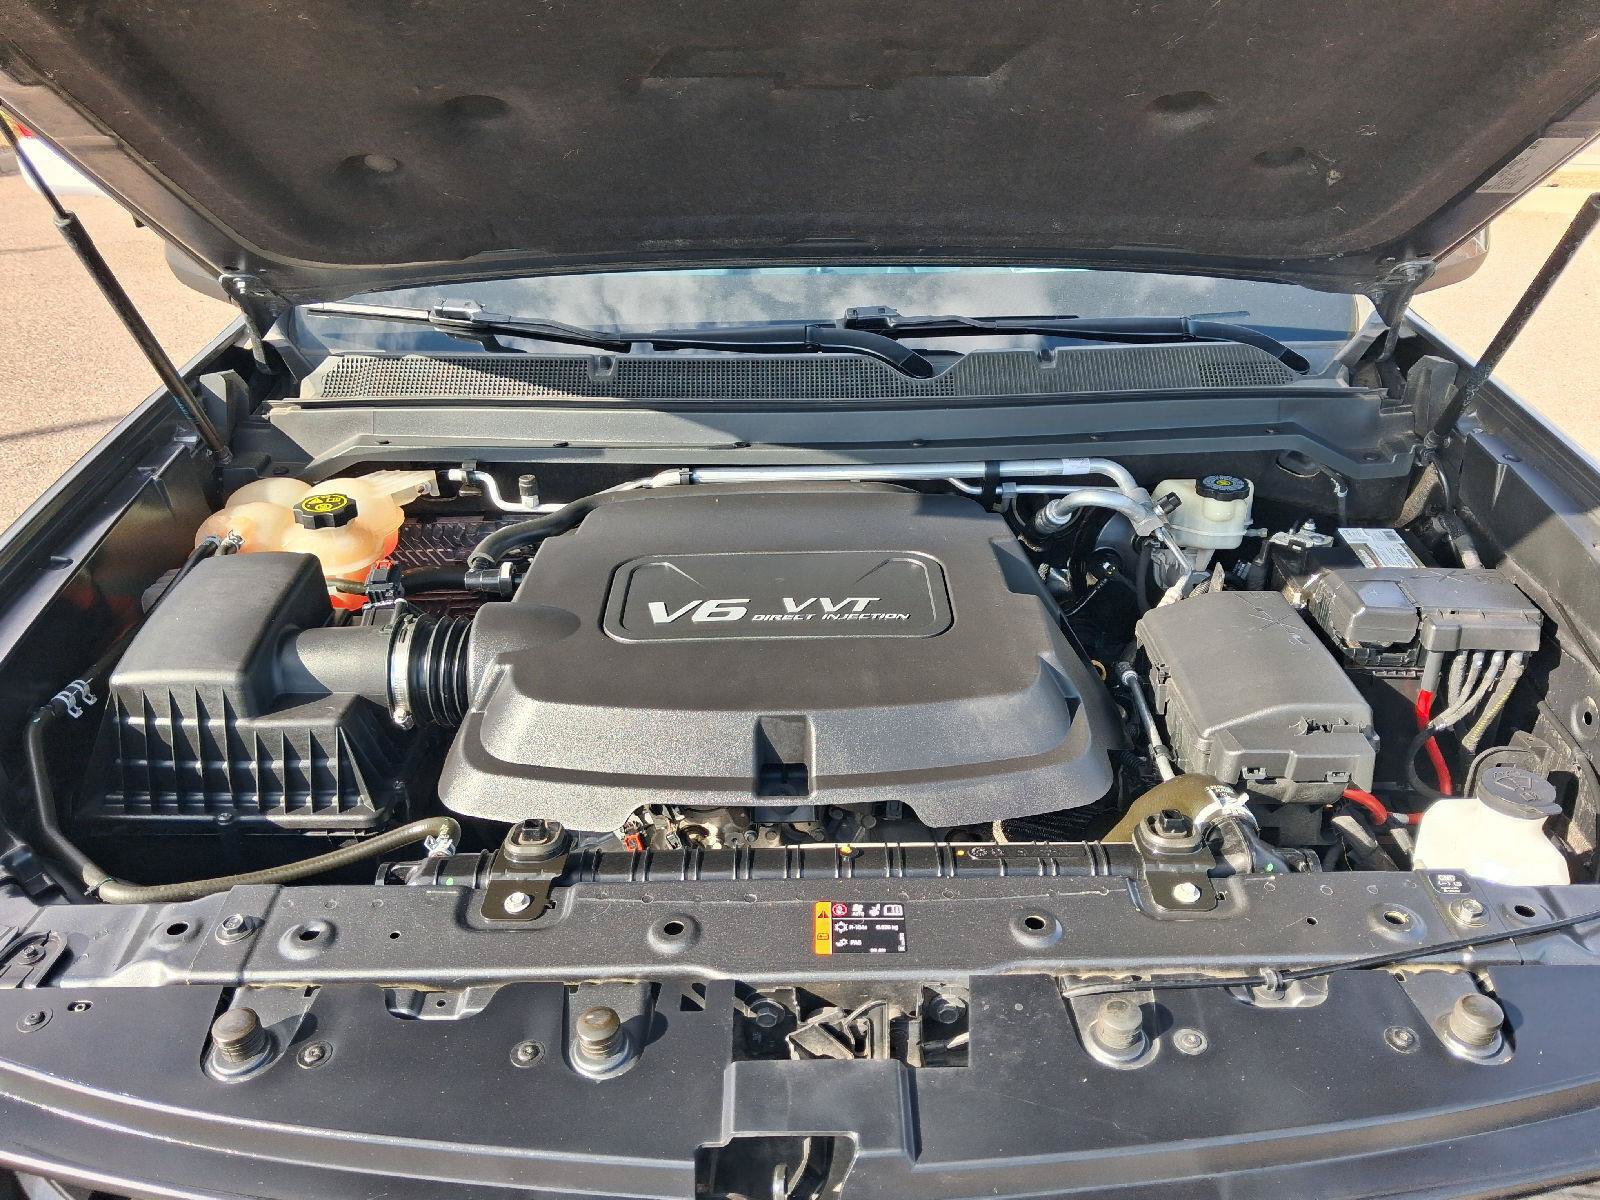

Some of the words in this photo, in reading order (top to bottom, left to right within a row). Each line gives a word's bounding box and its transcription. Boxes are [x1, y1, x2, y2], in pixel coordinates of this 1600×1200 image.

[648, 599, 750, 624] V6
[782, 597, 881, 613] VVT
[752, 613, 815, 621] DIRECT
[821, 612, 911, 621] INJECTION
